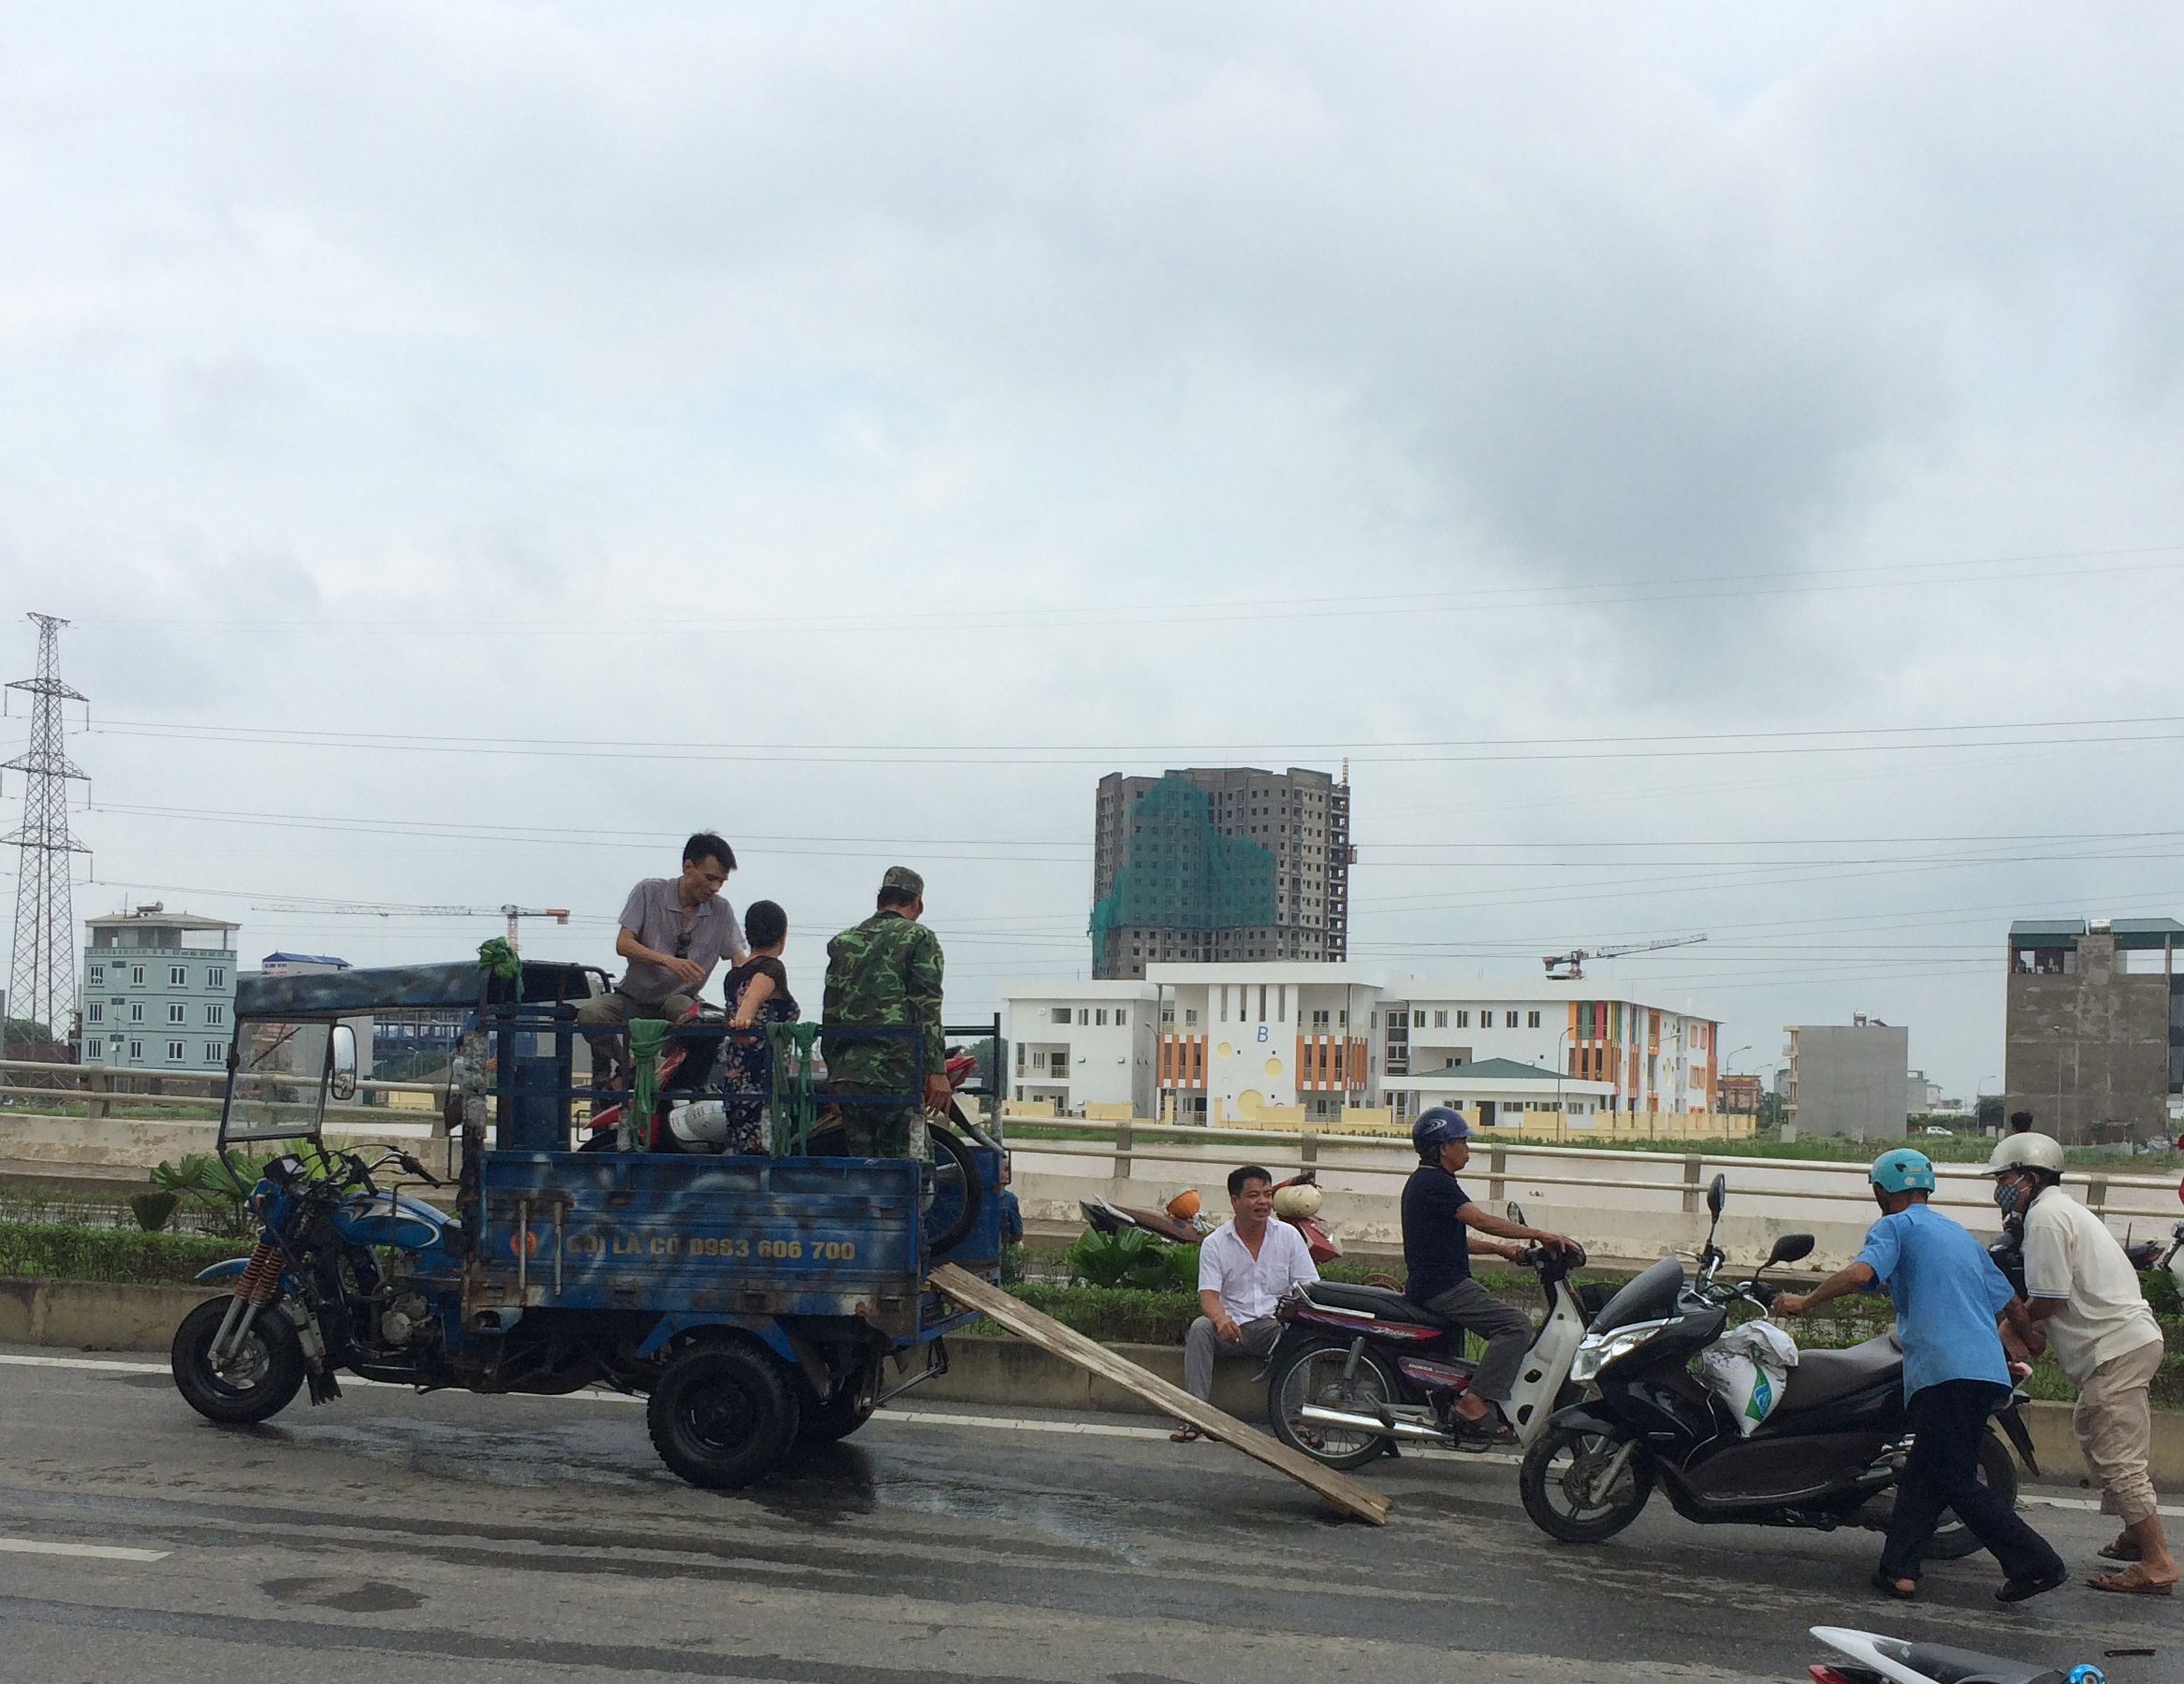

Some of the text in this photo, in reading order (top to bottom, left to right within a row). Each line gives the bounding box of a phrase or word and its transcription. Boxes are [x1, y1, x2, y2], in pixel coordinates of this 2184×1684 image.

[1257, 1025, 1269, 1043] B
[649, 1232, 681, 1255] CÓ
[758, 1240, 802, 1259] 606
[810, 1241, 855, 1260] 700
